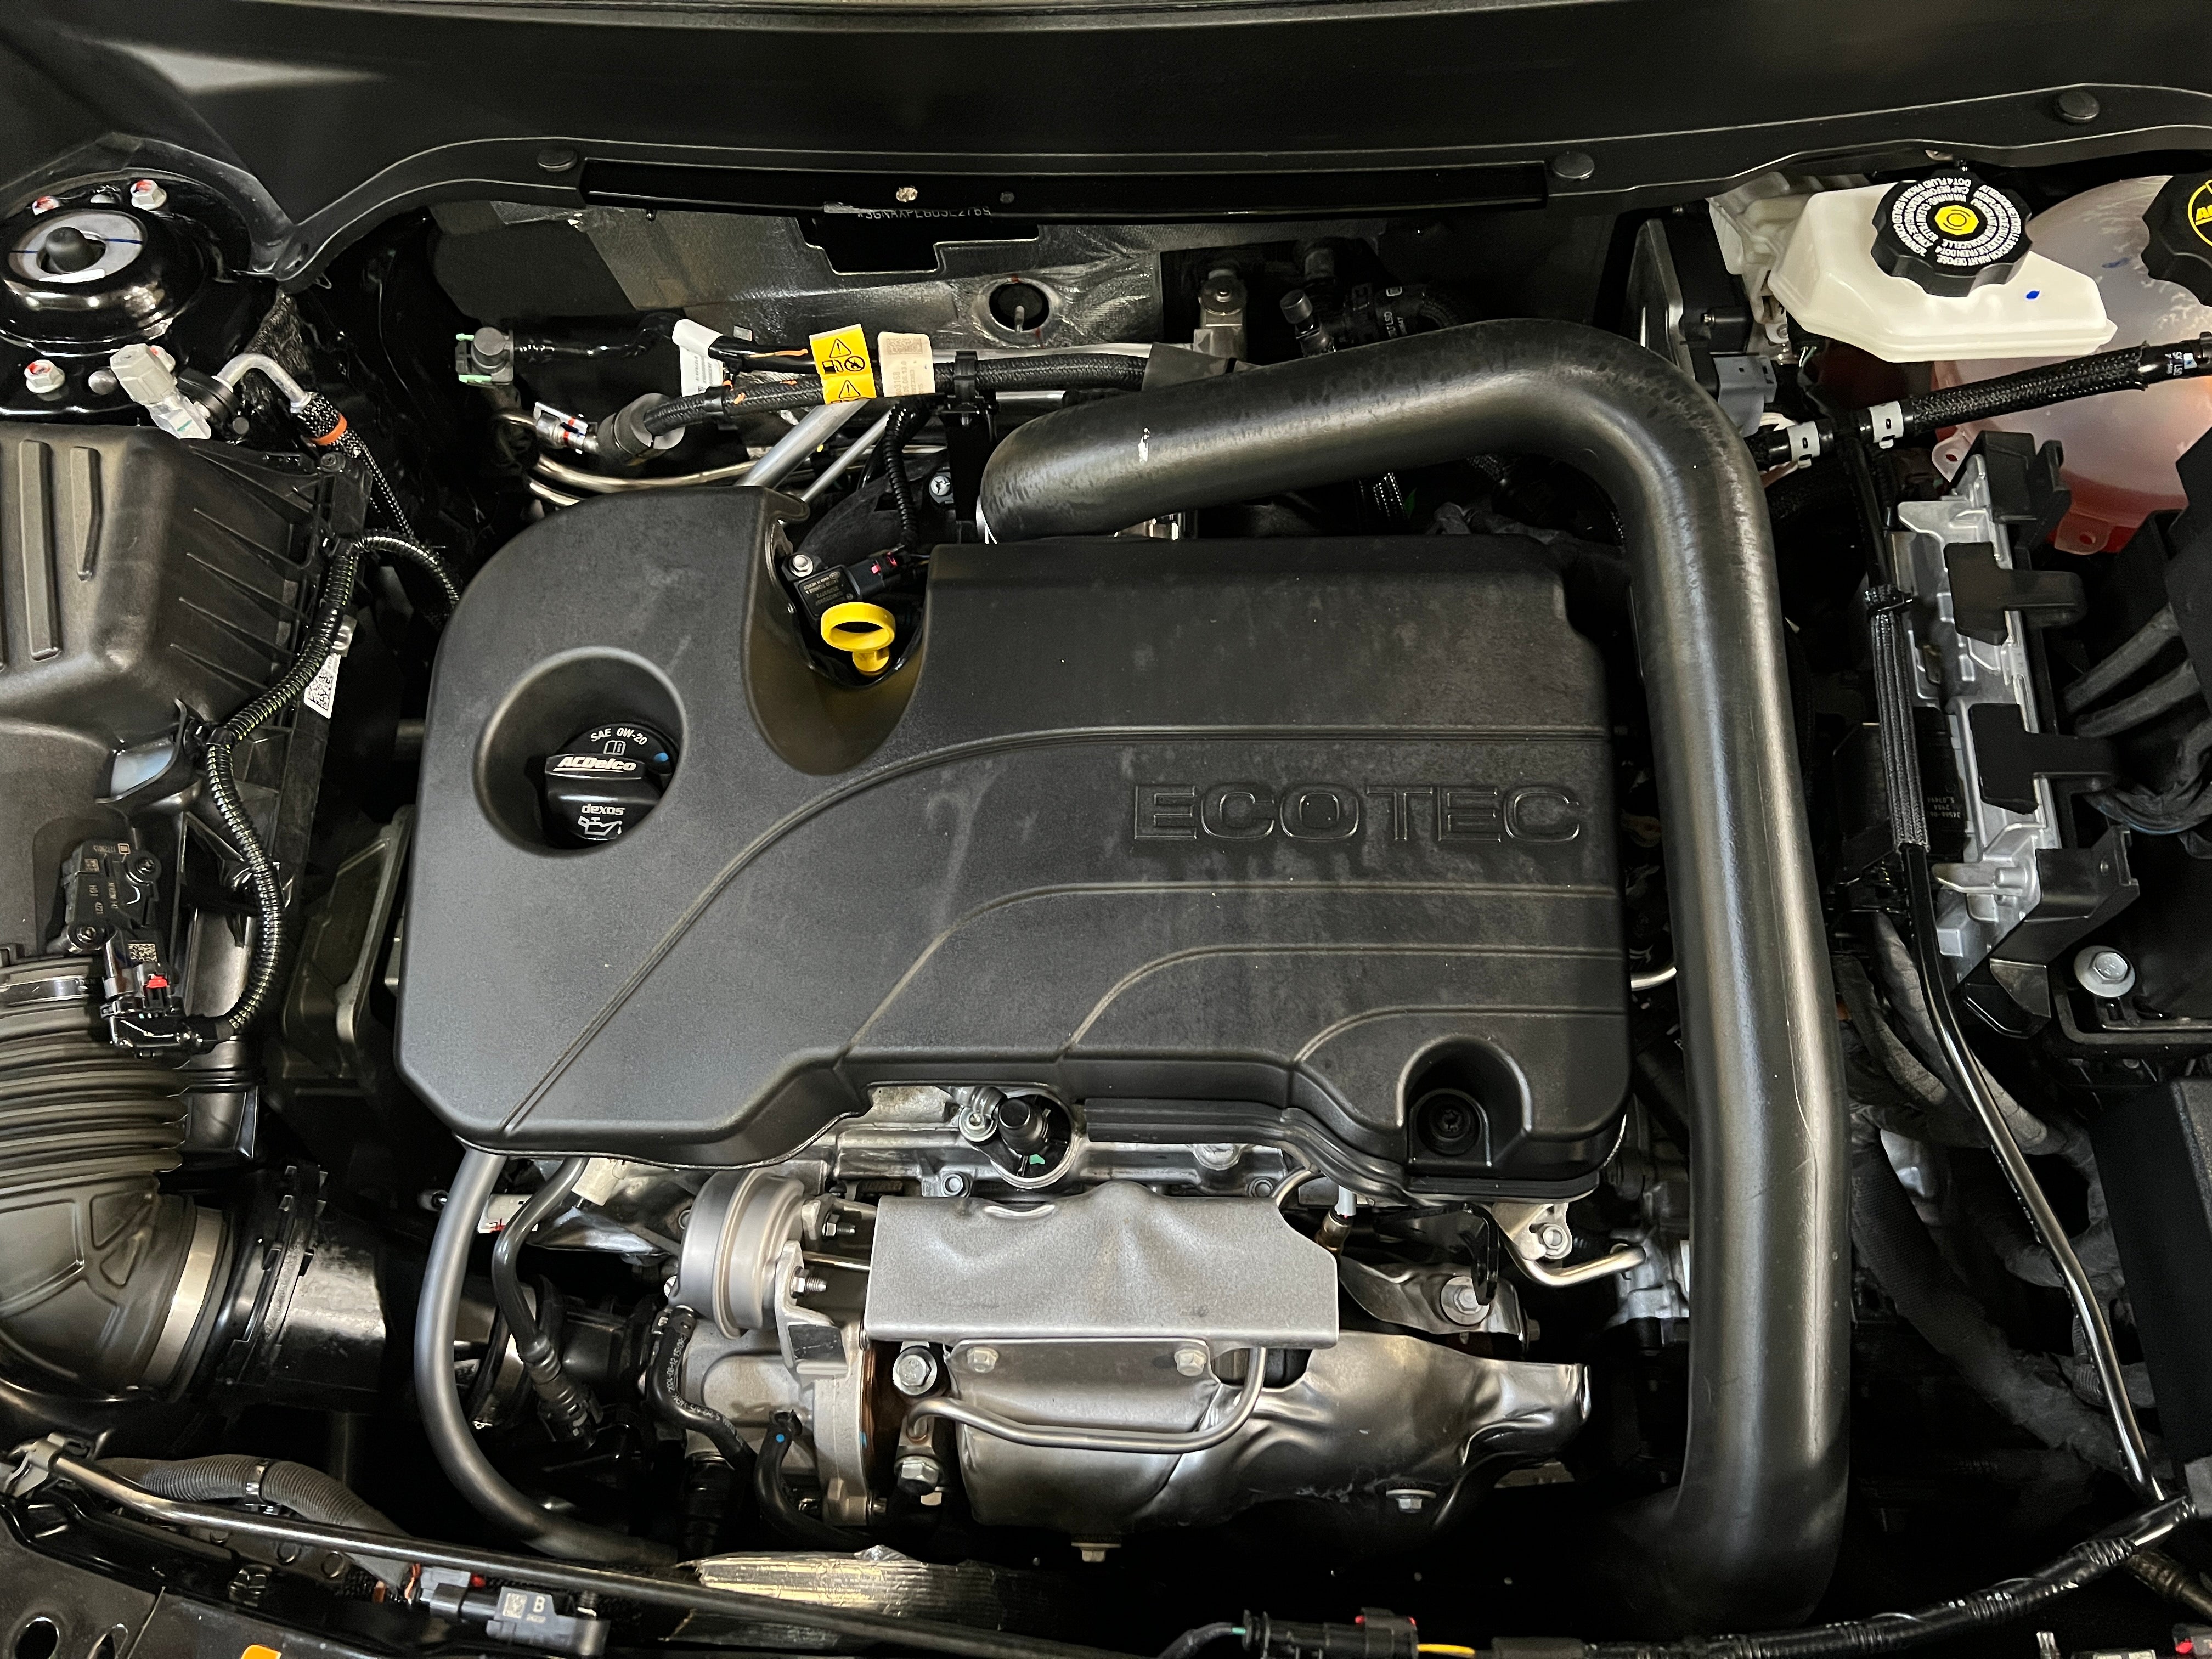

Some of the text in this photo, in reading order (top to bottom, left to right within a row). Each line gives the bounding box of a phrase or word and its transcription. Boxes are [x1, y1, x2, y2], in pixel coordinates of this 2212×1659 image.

[1922, 178, 1948, 188] FLUID
[1951, 185, 1970, 194] CAP
[1953, 178, 1972, 187] DOT
[1902, 183, 1925, 199] FROM
[1920, 185, 1951, 199] BEFORE
[1892, 200, 1906, 223] SEALED
[1916, 203, 1931, 222] CLEAN
[1917, 222, 1939, 242] FILLER
[2008, 233, 2020, 242] LE
[1910, 233, 1933, 248] ONLY
[1940, 247, 1956, 257] DOT
[1956, 249, 1979, 257] FREIN
[1976, 246, 1989, 255] DE
[1988, 239, 2016, 260] BOUCHON
[1967, 254, 1991, 266] AVANT
[590, 727, 648, 746] SAE 0W-20
[557, 755, 636, 772] ACDelco
[582, 803, 625, 816] dexos
[1133, 782, 1581, 843] ECOTEC
[533, 1595, 546, 1613] B
